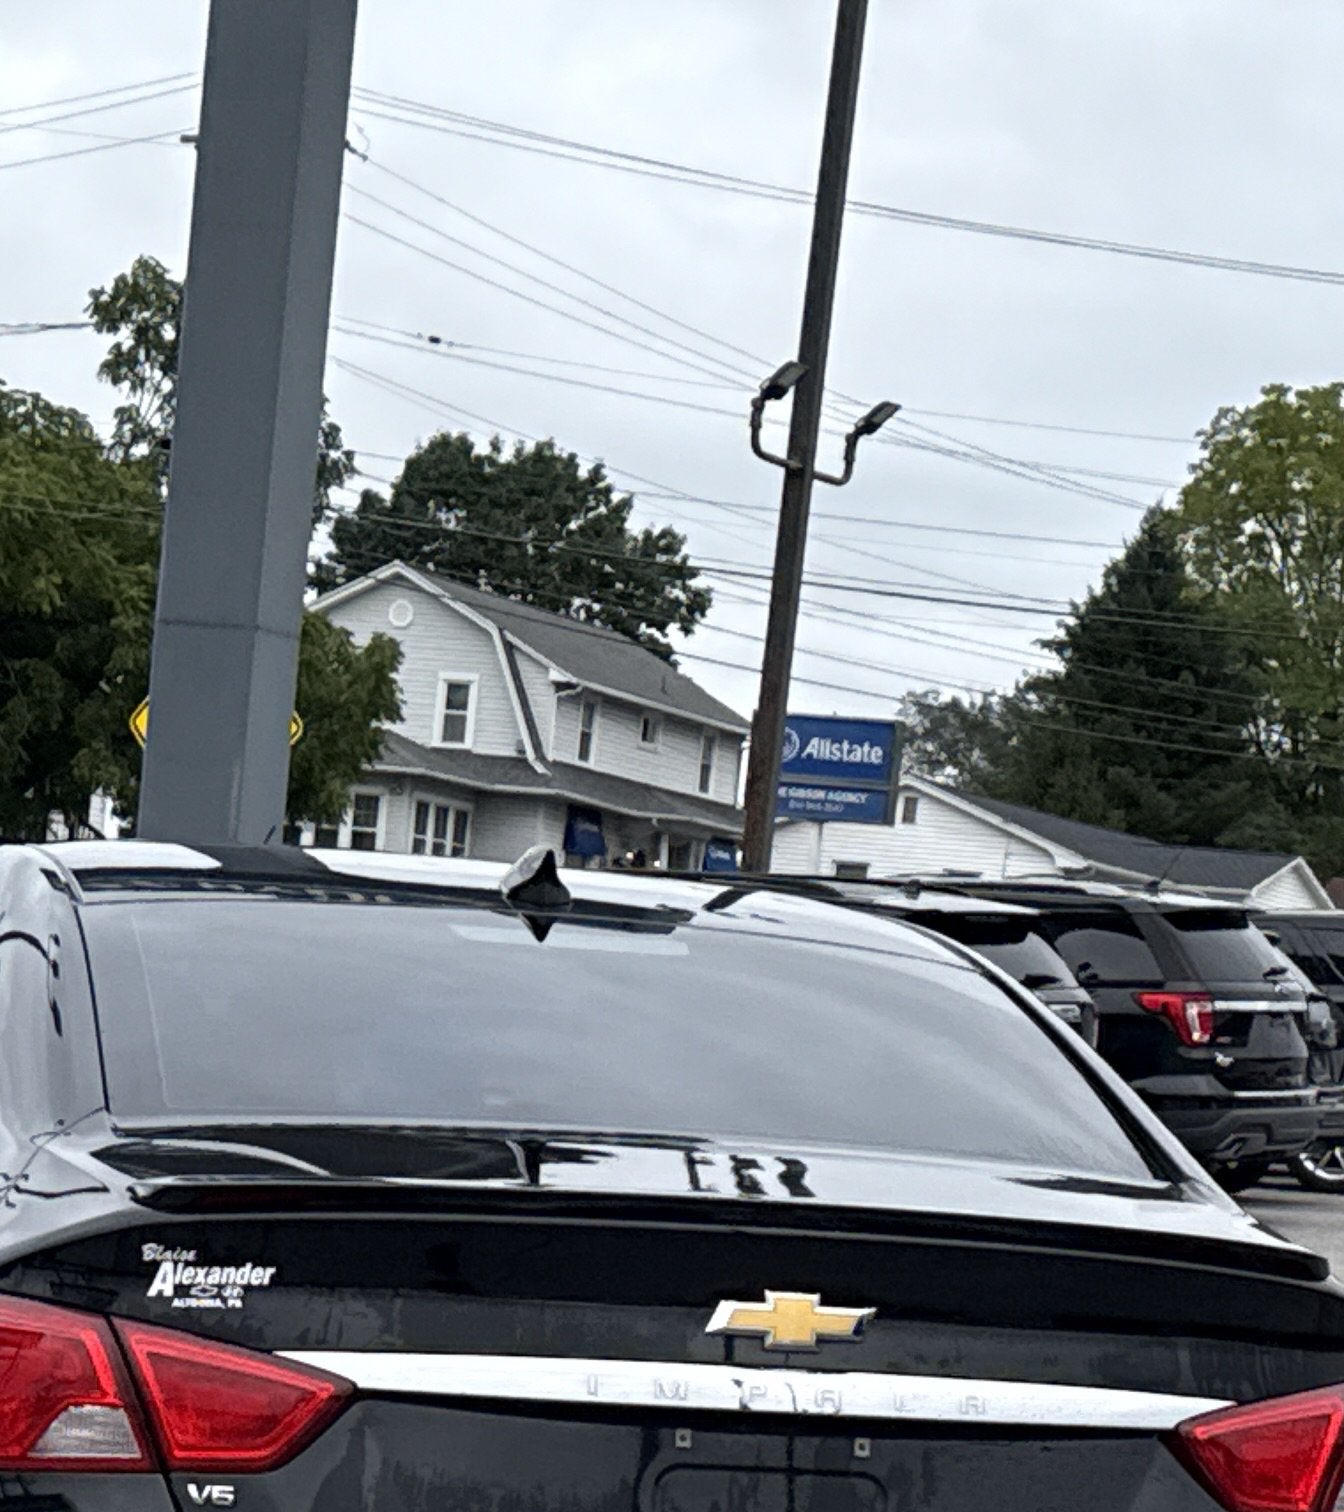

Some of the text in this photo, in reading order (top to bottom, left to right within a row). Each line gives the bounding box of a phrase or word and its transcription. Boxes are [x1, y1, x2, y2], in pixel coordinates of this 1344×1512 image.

[801, 736, 884, 765] Allstate
[141, 1243, 197, 1262] Blaise
[147, 1261, 276, 1297] Alexander
[586, 1374, 988, 1417] IMPALA
[186, 1483, 235, 1507] V6
